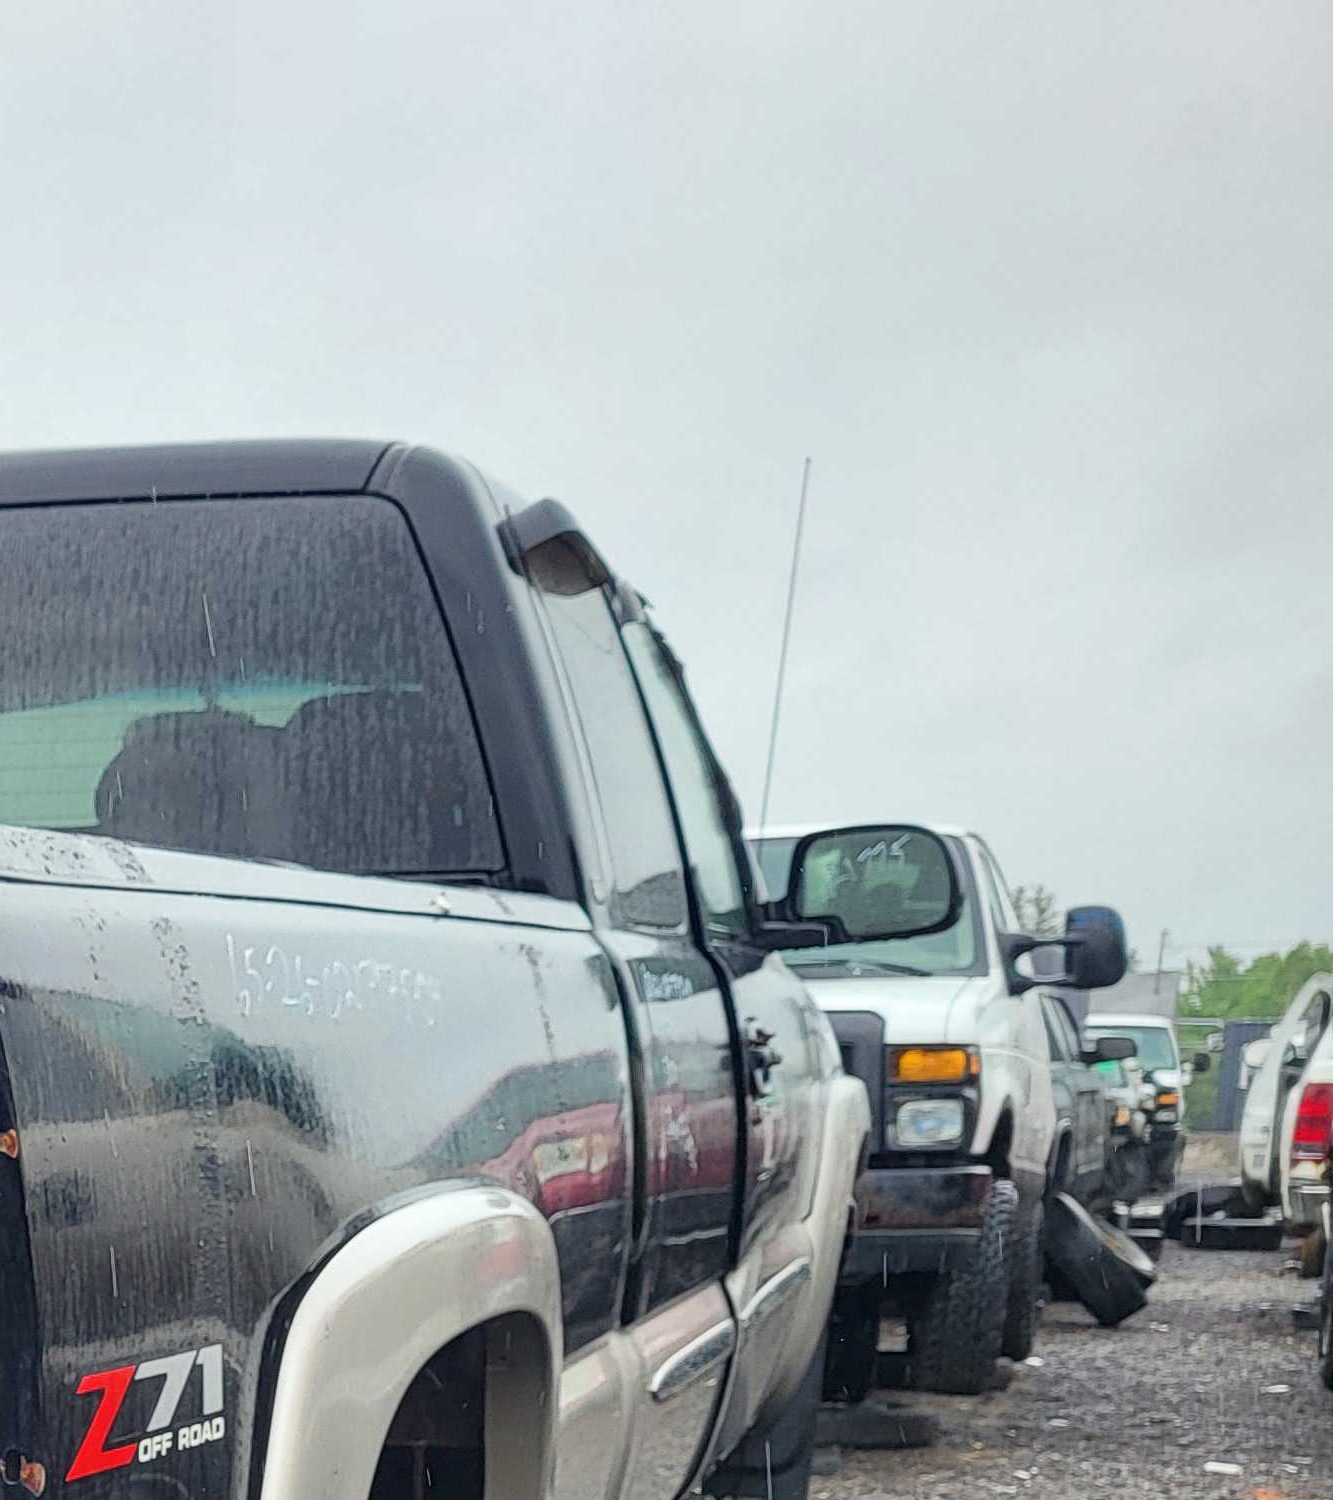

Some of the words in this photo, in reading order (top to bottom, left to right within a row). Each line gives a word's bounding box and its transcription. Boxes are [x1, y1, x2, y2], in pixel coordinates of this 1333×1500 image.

[65, 1343, 225, 1482] Z71
[138, 1431, 173, 1464] OFF
[178, 1416, 225, 1451] ROAD
